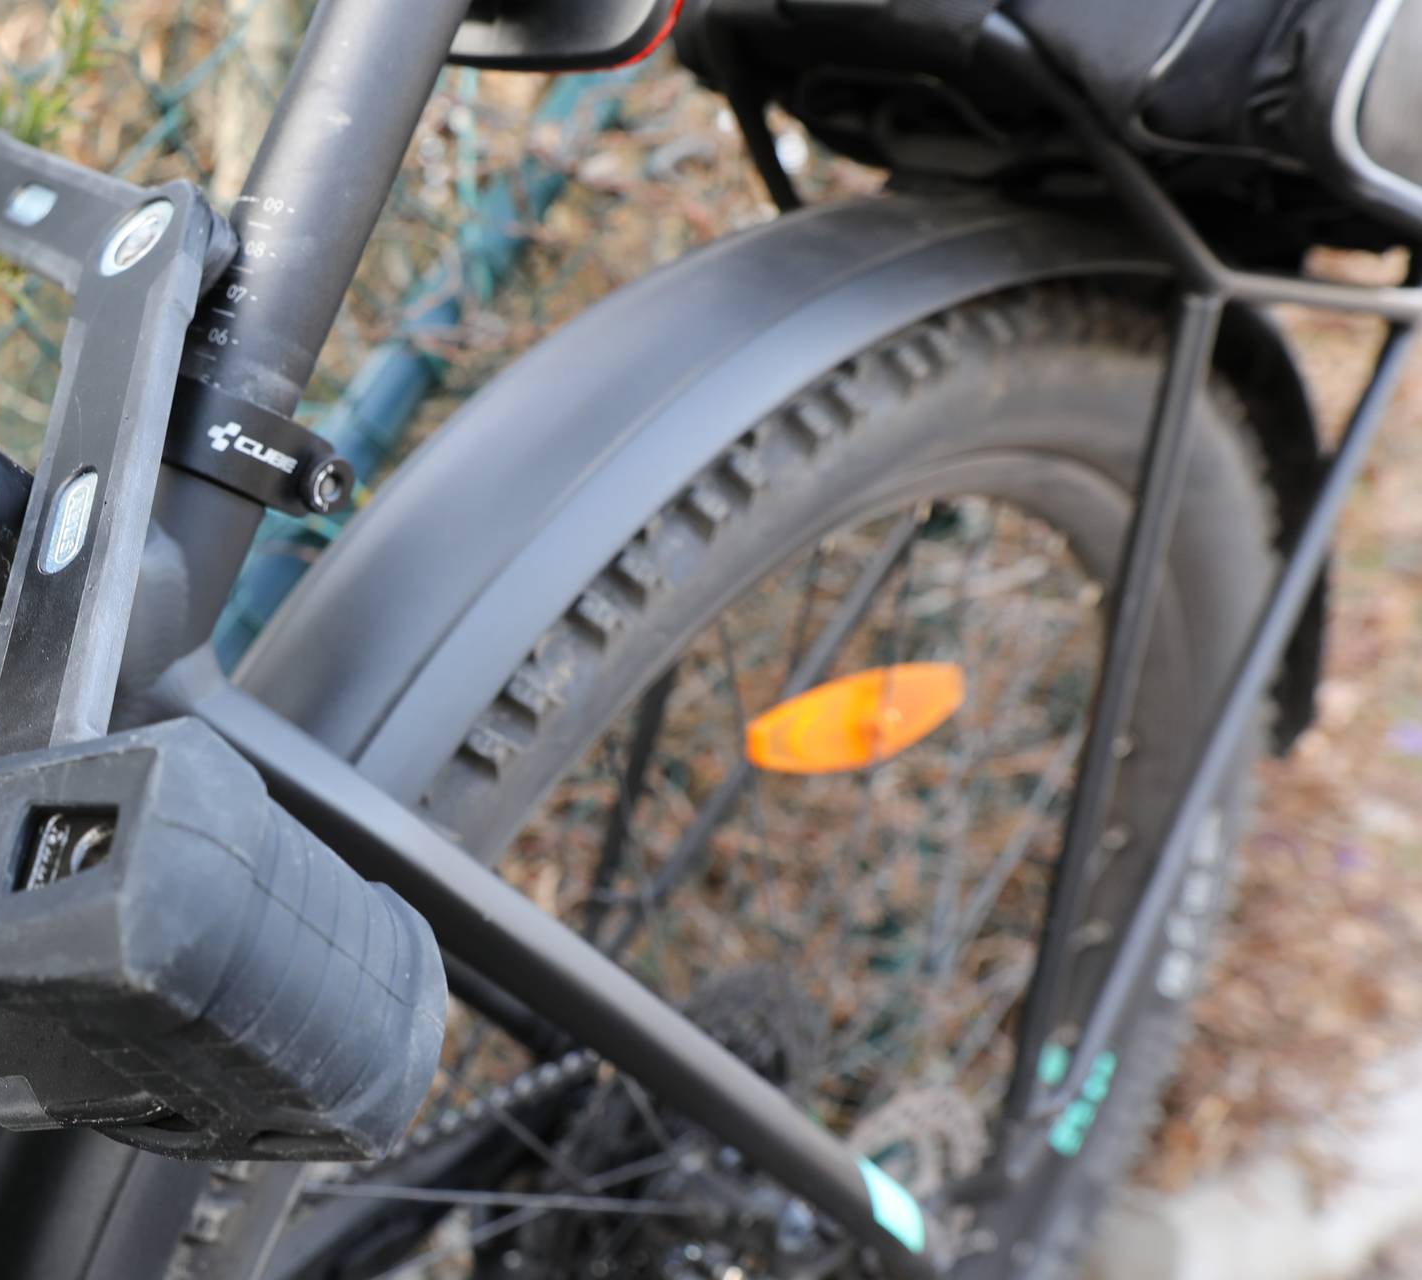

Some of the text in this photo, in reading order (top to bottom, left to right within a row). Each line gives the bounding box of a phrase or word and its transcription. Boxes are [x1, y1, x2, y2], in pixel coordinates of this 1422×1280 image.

[263, 196, 284, 216] 09
[245, 241, 266, 259] 08
[226, 285, 248, 304] 07
[208, 327, 229, 346] 06
[233, 434, 298, 475] CUBE
